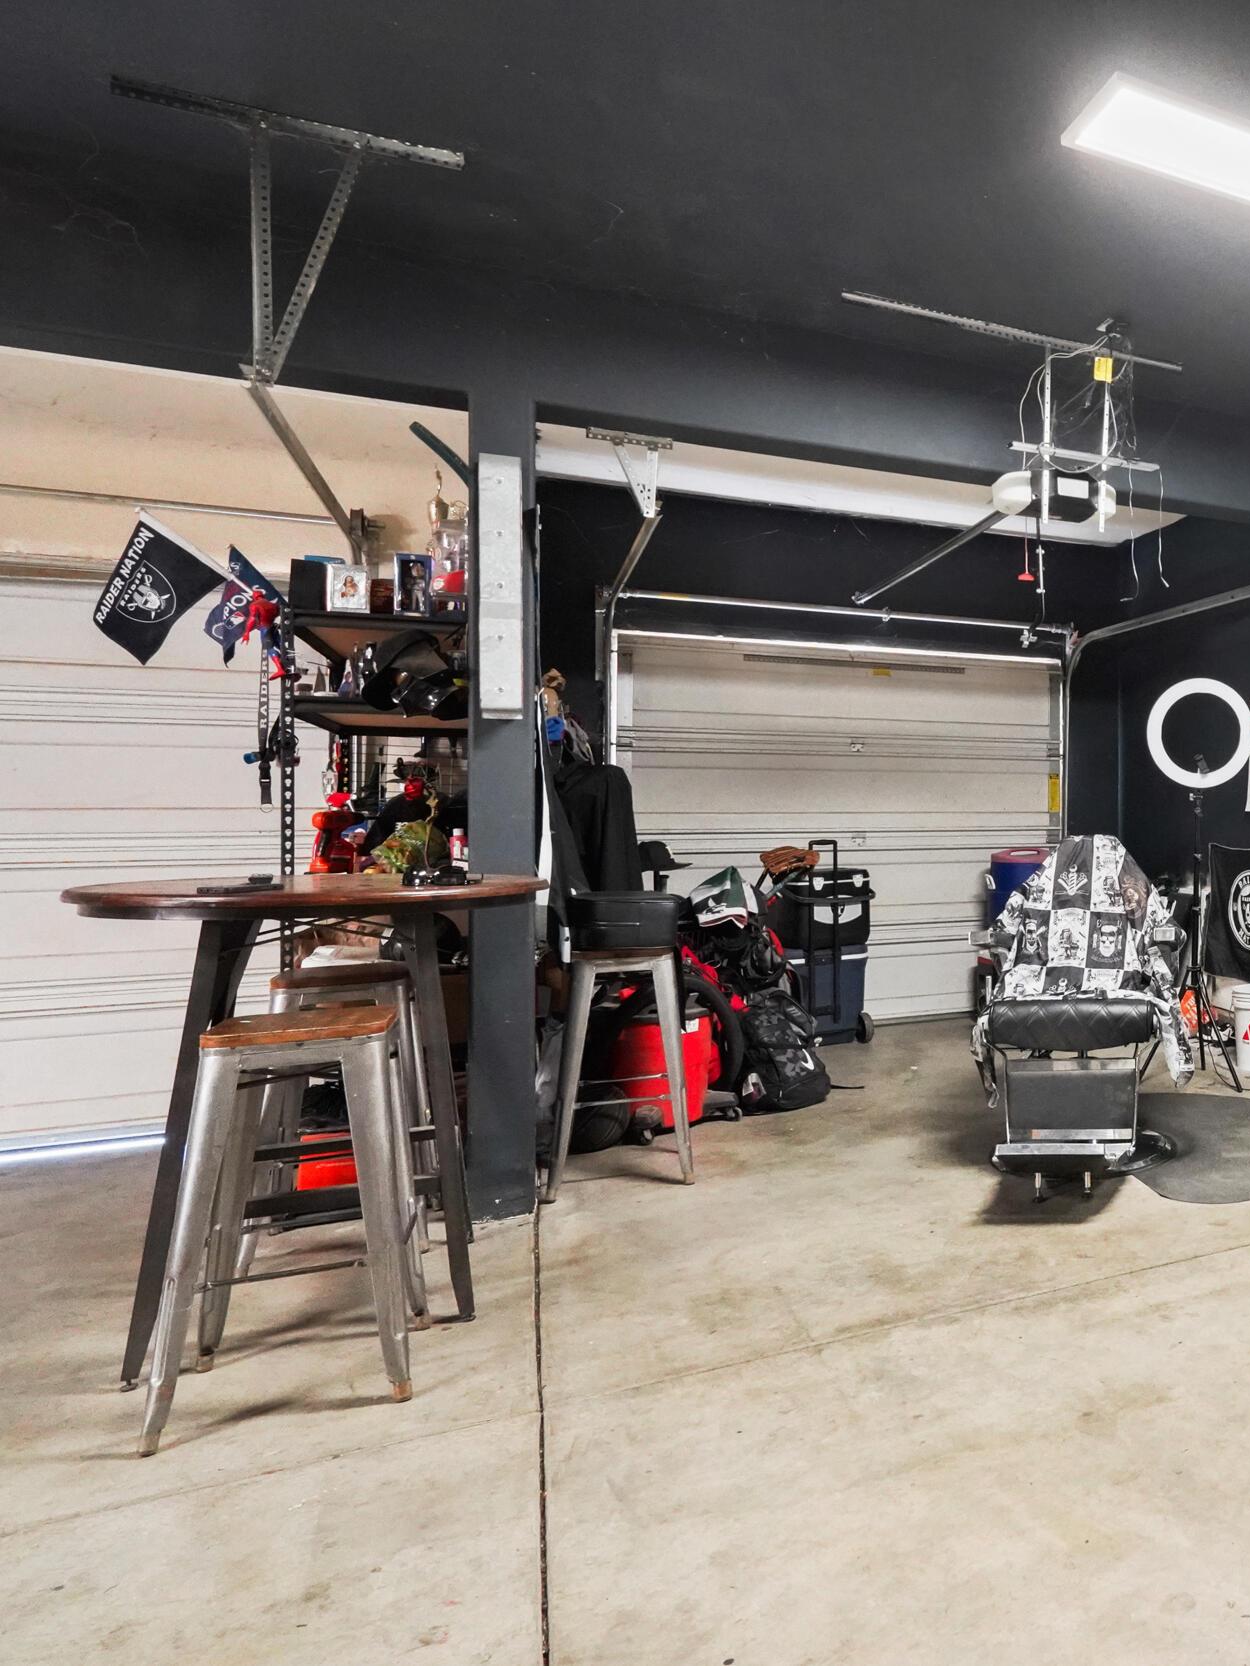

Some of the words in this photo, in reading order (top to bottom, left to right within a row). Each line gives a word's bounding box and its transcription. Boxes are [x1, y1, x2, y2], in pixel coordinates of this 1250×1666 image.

[95, 577, 125, 624] RAIDER
[119, 527, 155, 581] NATION
[120, 567, 147, 607] RAIDERS
